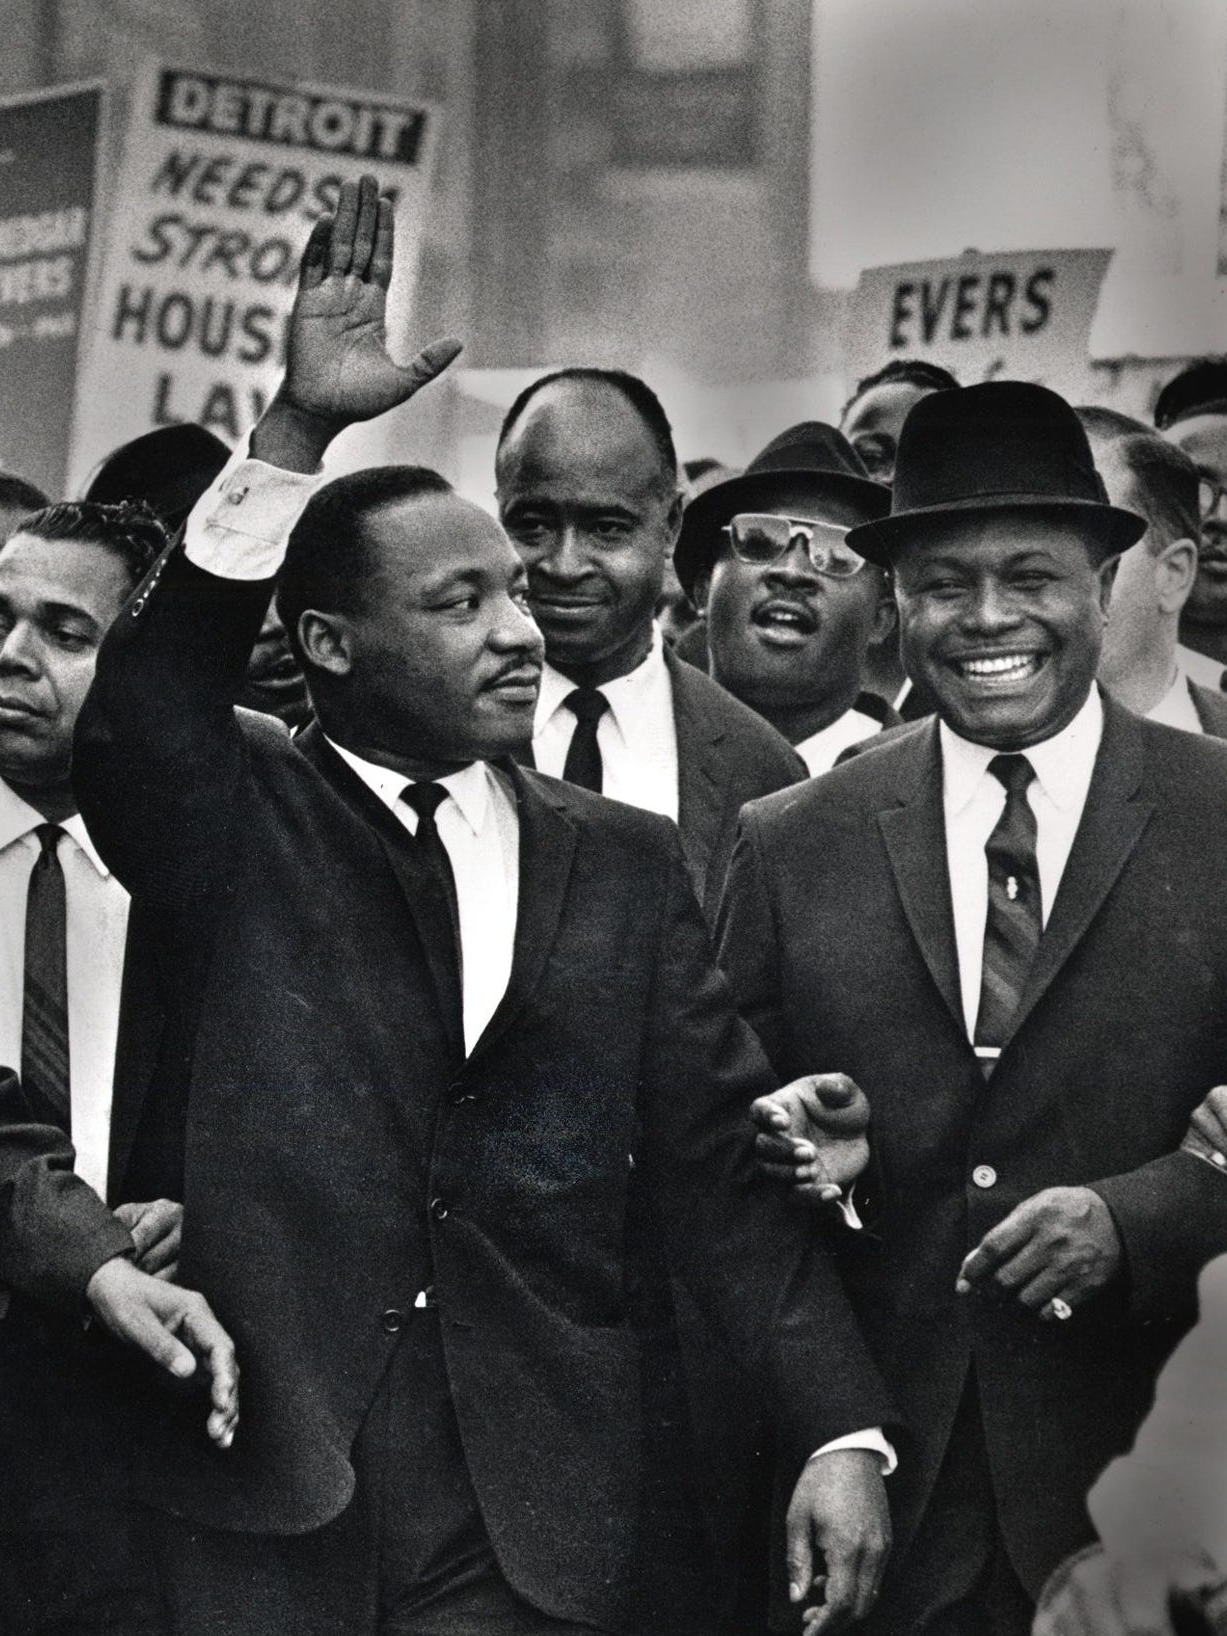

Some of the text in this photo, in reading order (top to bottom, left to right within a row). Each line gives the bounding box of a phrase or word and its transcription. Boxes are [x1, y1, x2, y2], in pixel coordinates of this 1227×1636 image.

[171, 77, 412, 156] DETROIT
[152, 151, 341, 218] NEEDS
[130, 213, 297, 286] STRO
[114, 284, 276, 364] HOUS
[889, 267, 1057, 350] EVERS
